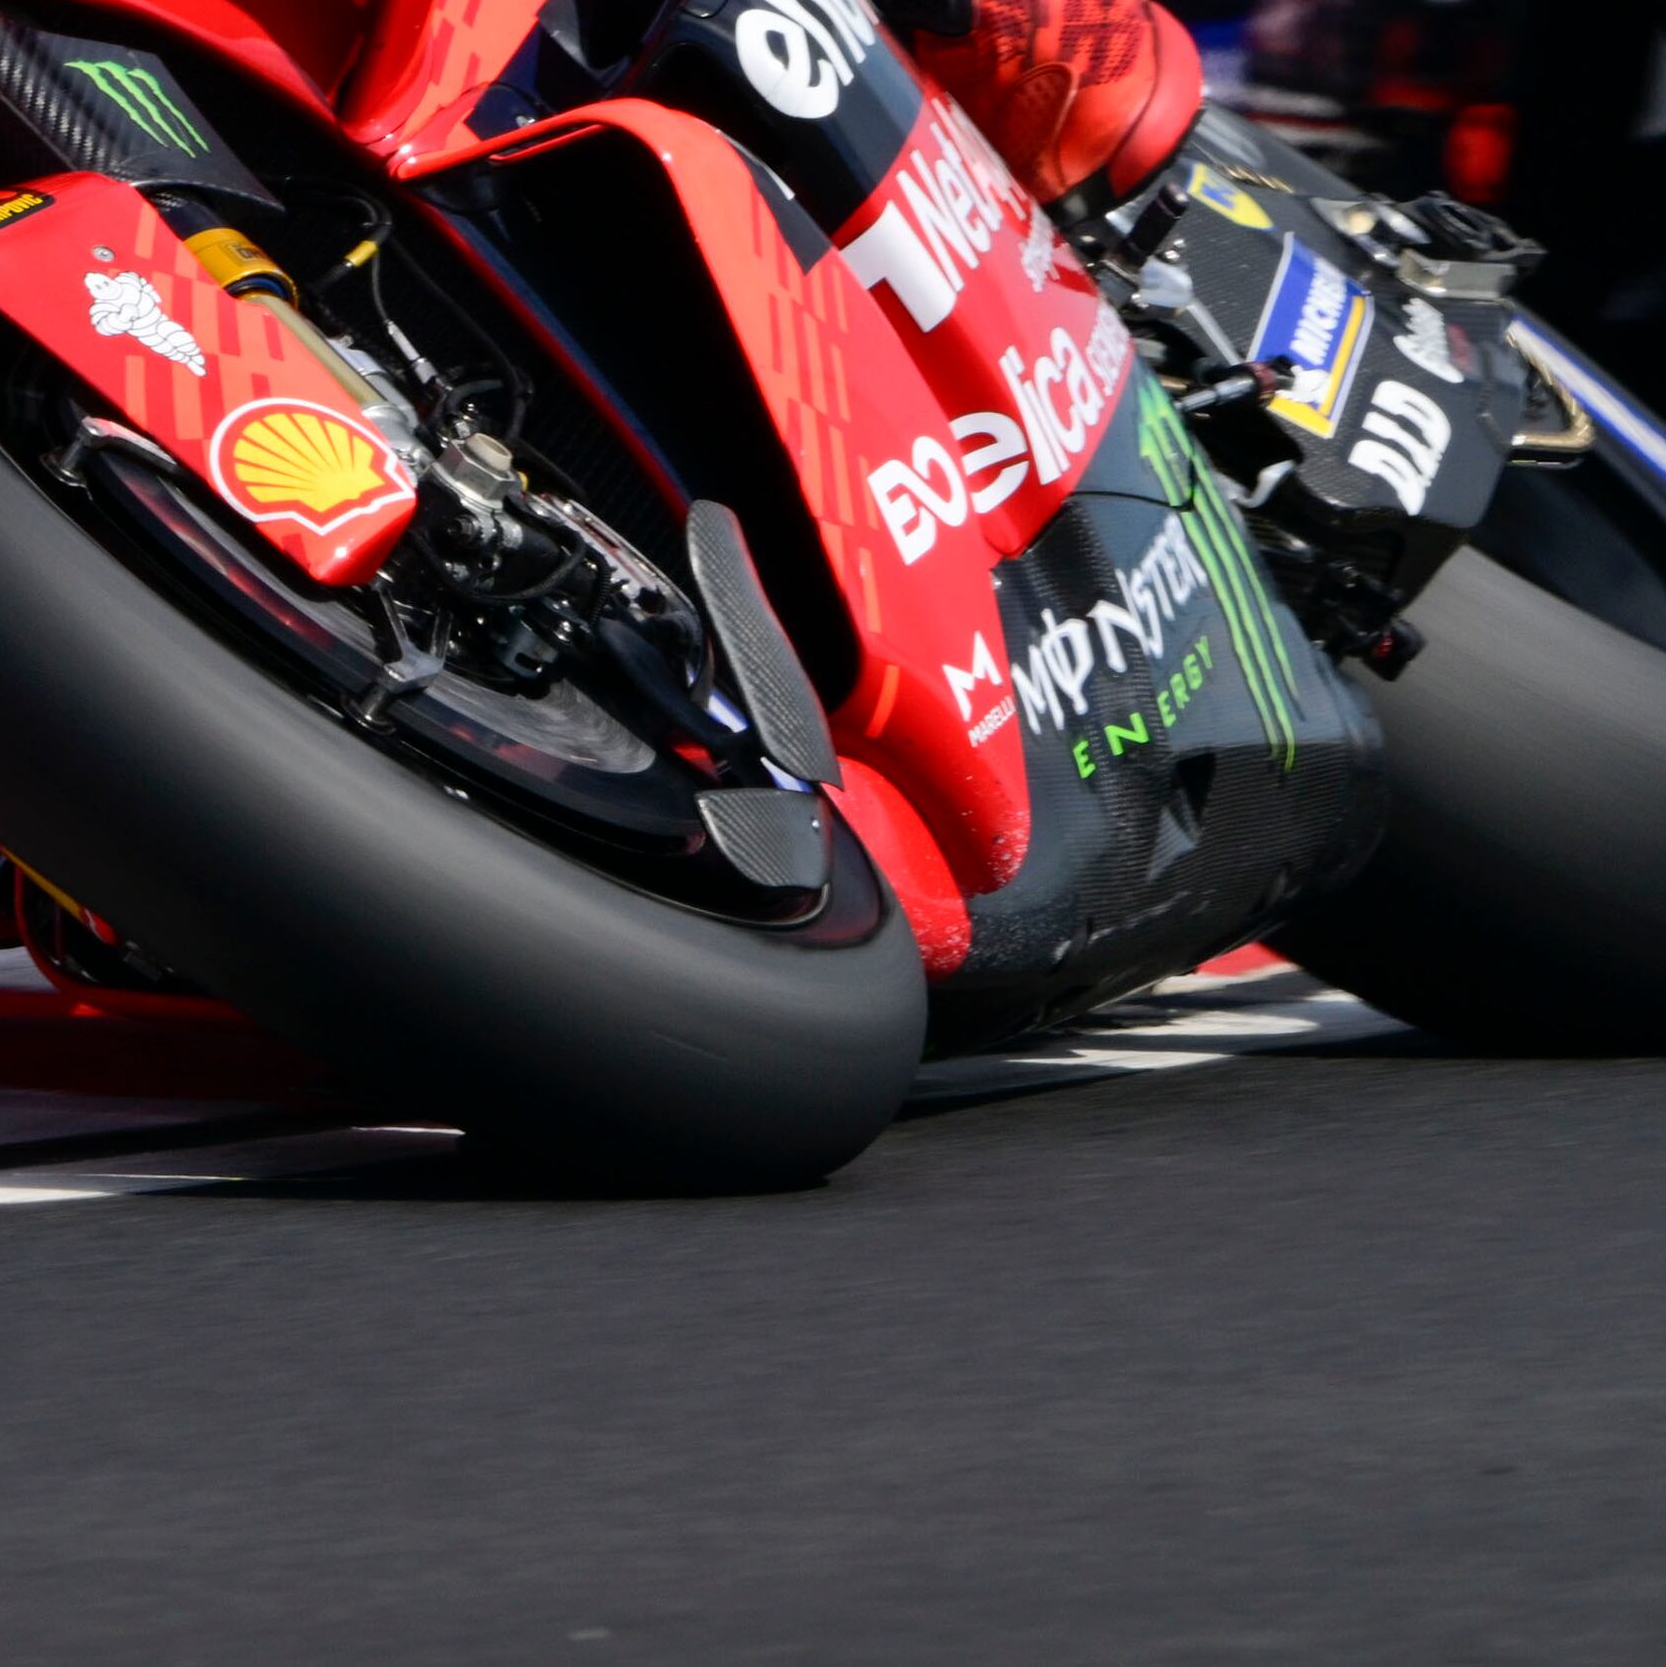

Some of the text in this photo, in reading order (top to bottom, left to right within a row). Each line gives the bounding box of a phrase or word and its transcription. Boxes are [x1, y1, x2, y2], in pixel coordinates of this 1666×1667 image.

[1010, 512, 1209, 736] MONSTER
[967, 694, 1018, 749] MARELLI
[1072, 635, 1214, 780] ENERGY
